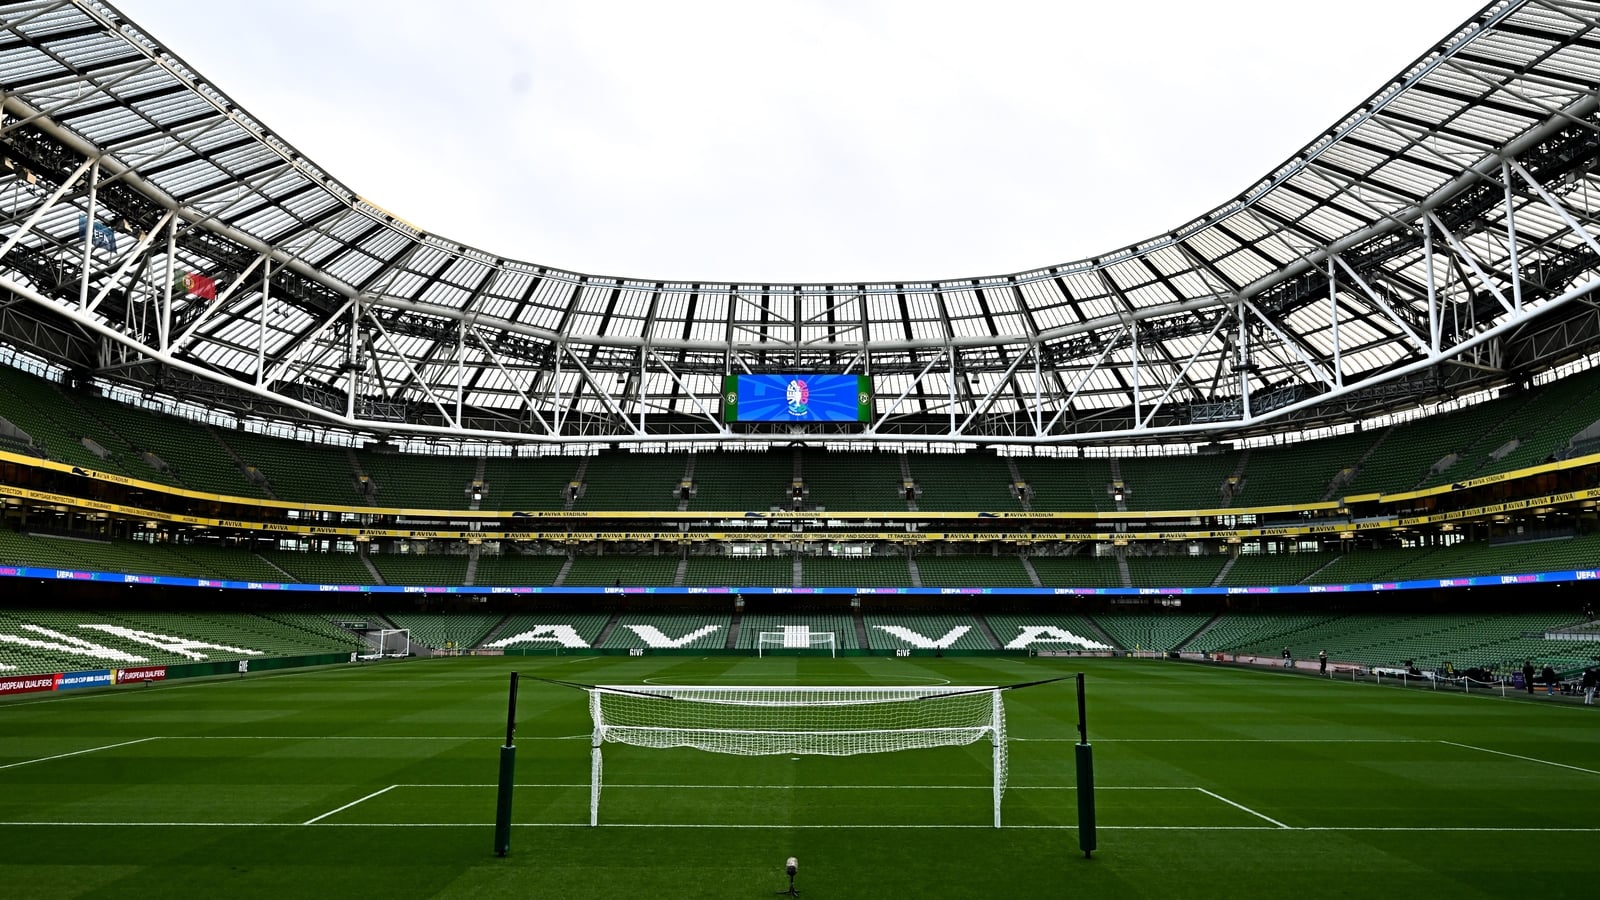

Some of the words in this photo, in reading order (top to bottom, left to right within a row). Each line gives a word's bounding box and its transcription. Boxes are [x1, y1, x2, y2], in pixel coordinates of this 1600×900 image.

[1531, 497, 1548, 506] AVIVA
[1556, 493, 1574, 502] AVIVA
[1486, 505, 1502, 513] AVIVA
[1508, 502, 1524, 510] AVIVA
[1448, 511, 1462, 519] AVIVA
[1466, 508, 1480, 516] AVIVA
[56, 570, 74, 579] UEFA
[1576, 571, 1597, 580] UEFA
[124, 575, 139, 583] UEFA
[1440, 579, 1454, 587] UEFA
[1501, 576, 1518, 584] UEFA
[125, 671, 144, 680] EUROPEAN
[145, 669, 166, 678] QUALIFIERS
[25, 678, 53, 688] QUALIFIERS
